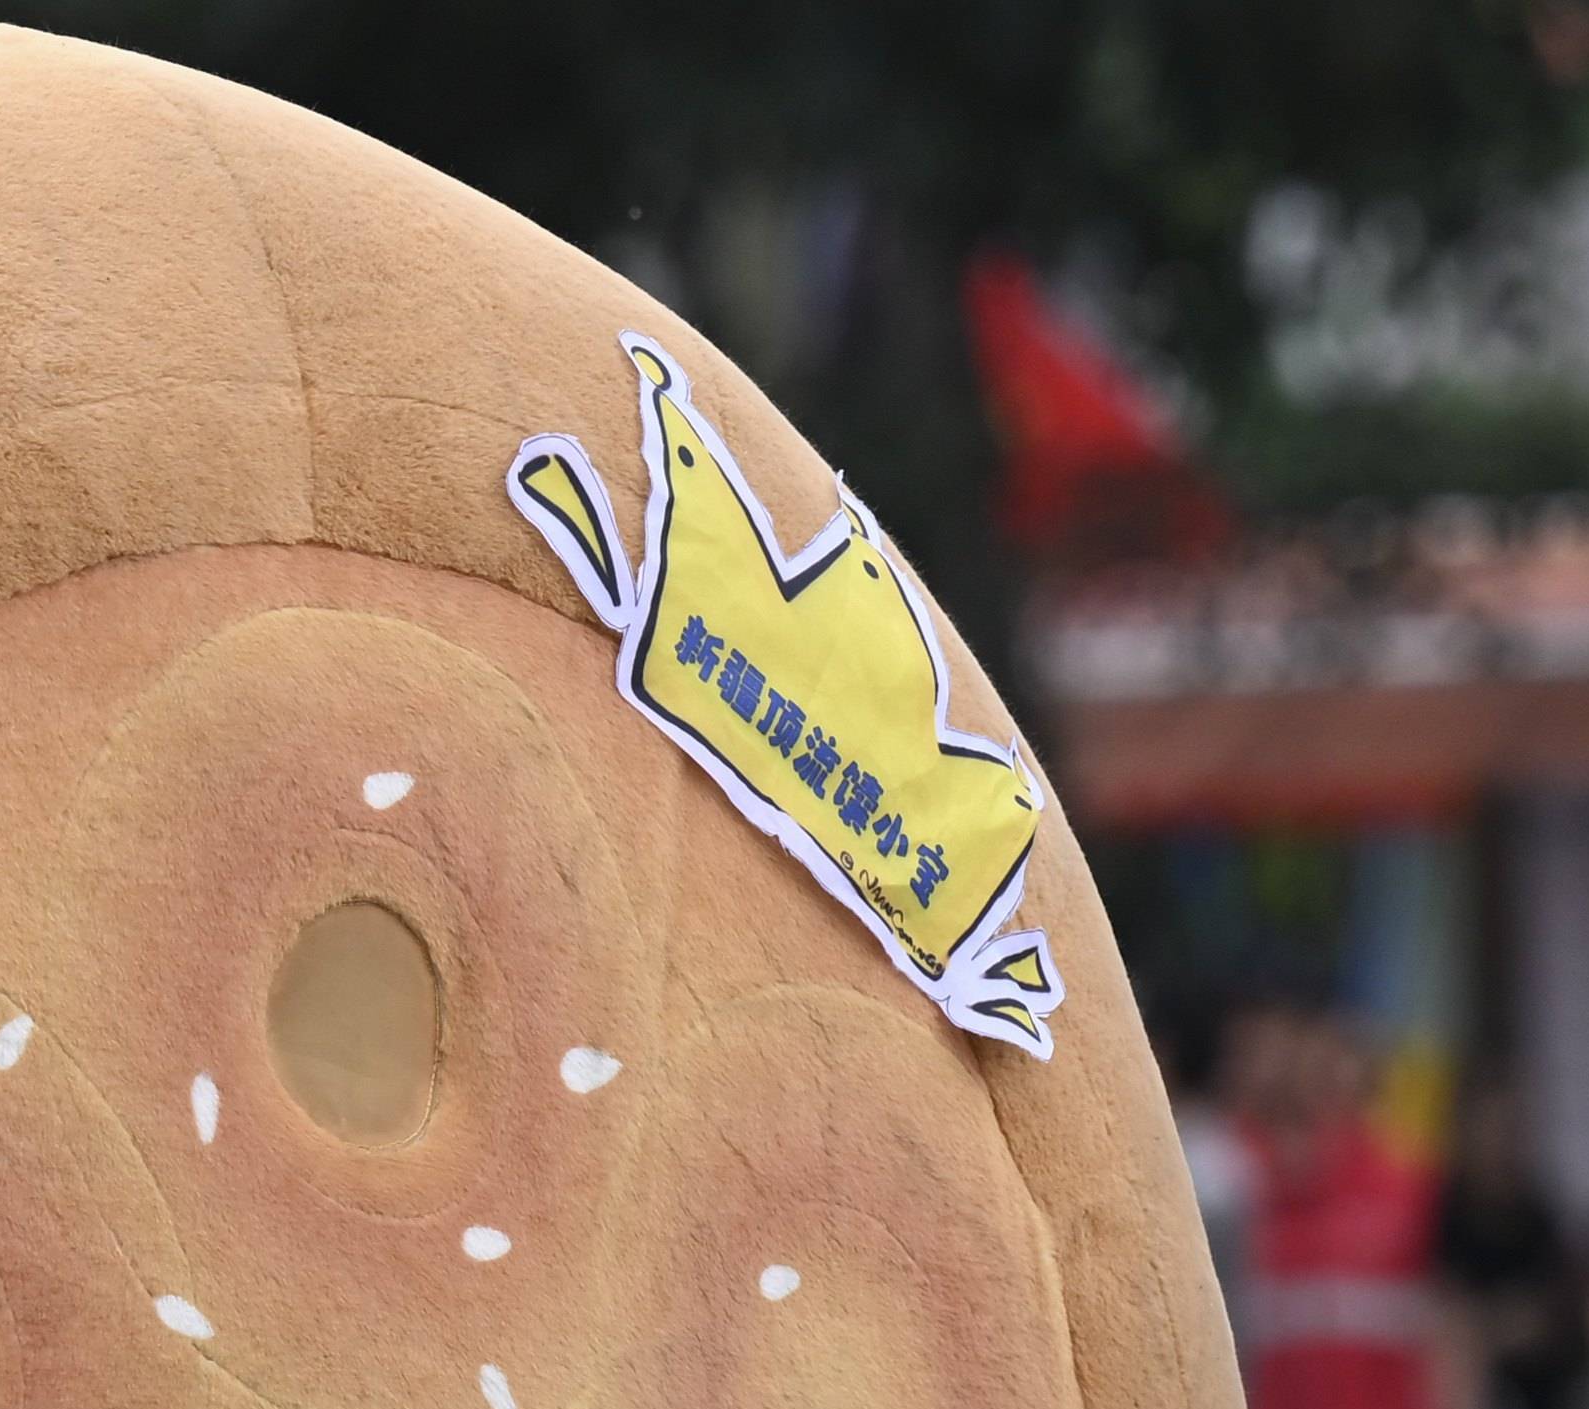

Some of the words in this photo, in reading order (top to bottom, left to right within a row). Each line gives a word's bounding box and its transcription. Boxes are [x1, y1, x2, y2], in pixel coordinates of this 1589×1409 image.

[674, 614, 950, 909] 新疆顶流馕小宝
